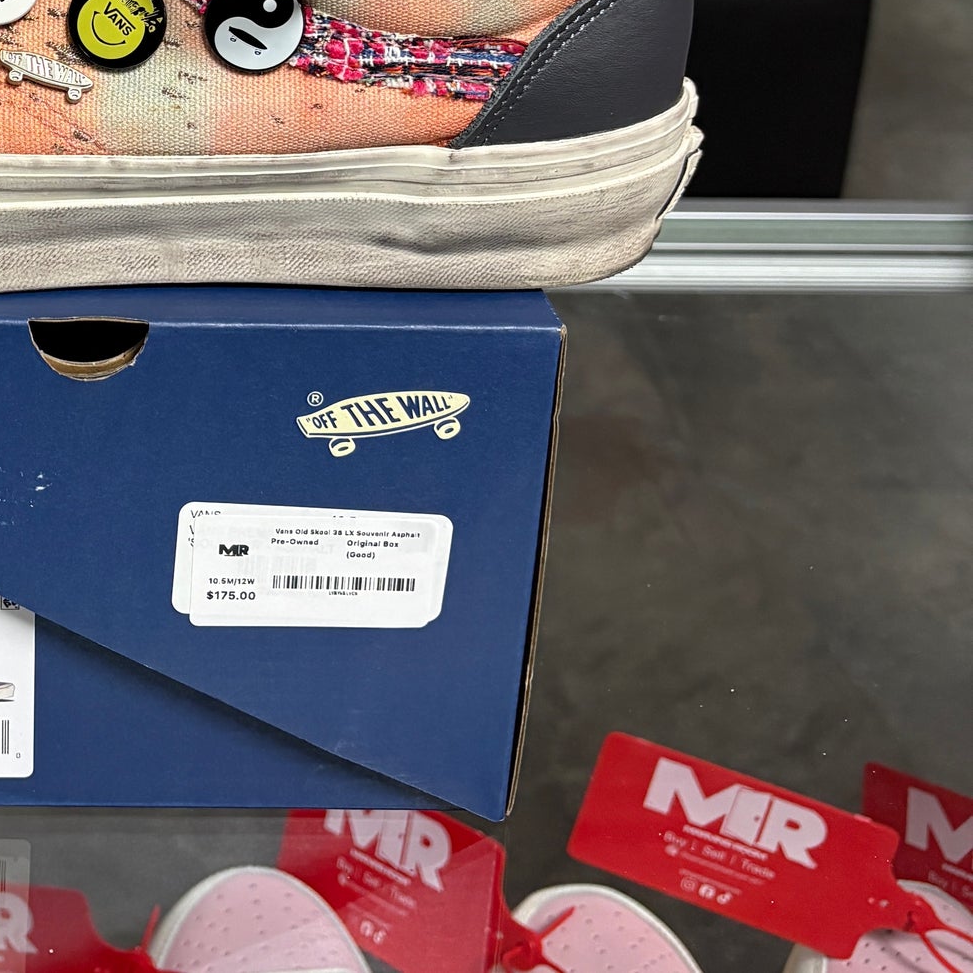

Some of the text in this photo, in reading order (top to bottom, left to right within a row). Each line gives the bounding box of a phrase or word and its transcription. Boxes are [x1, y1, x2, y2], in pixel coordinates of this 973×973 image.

[103, 1, 136, 36] VANS
[26, 54, 53, 79] THE
[340, 397, 401, 428] THE
[271, 538, 319, 546] Pre-Owned
[347, 539, 399, 548] Original Box
[346, 551, 376, 559] (Good)
[208, 578, 255, 586] 10.5M/12W
[206, 590, 256, 600] $175.00
